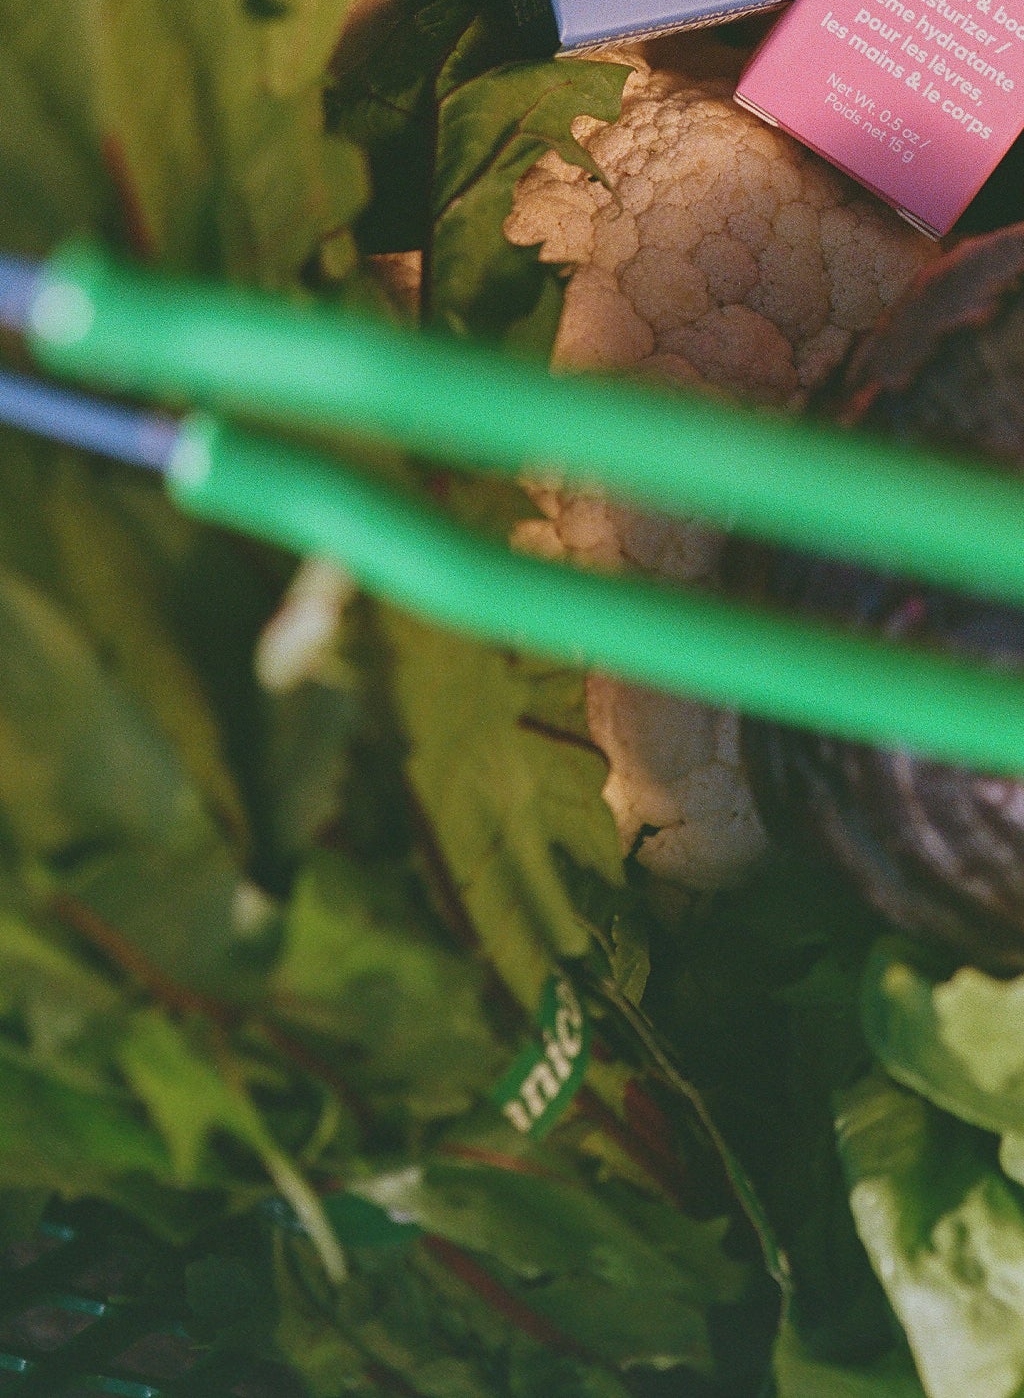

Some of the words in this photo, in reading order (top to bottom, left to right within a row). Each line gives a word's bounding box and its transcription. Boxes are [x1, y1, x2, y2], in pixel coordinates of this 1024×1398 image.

[821, 12, 848, 39] les
[848, 35, 904, 78] mains
[905, 72, 921, 90] &
[922, 82, 940, 103] le
[942, 99, 993, 138] corps
[854, 9, 901, 42] pour
[901, 36, 928, 63] les
[928, 54, 982, 106] lèvres,
[916, 15, 1014, 92] hydratante
[824, 92, 861, 124] Poids
[862, 121, 886, 141] net
[889, 136, 904, 152] 15
[902, 150, 915, 163] g
[827, 73, 853, 96] Net
[854, 90, 875, 112] Wt.
[879, 109, 903, 130] 0.5
[902, 128, 920, 144] oz
